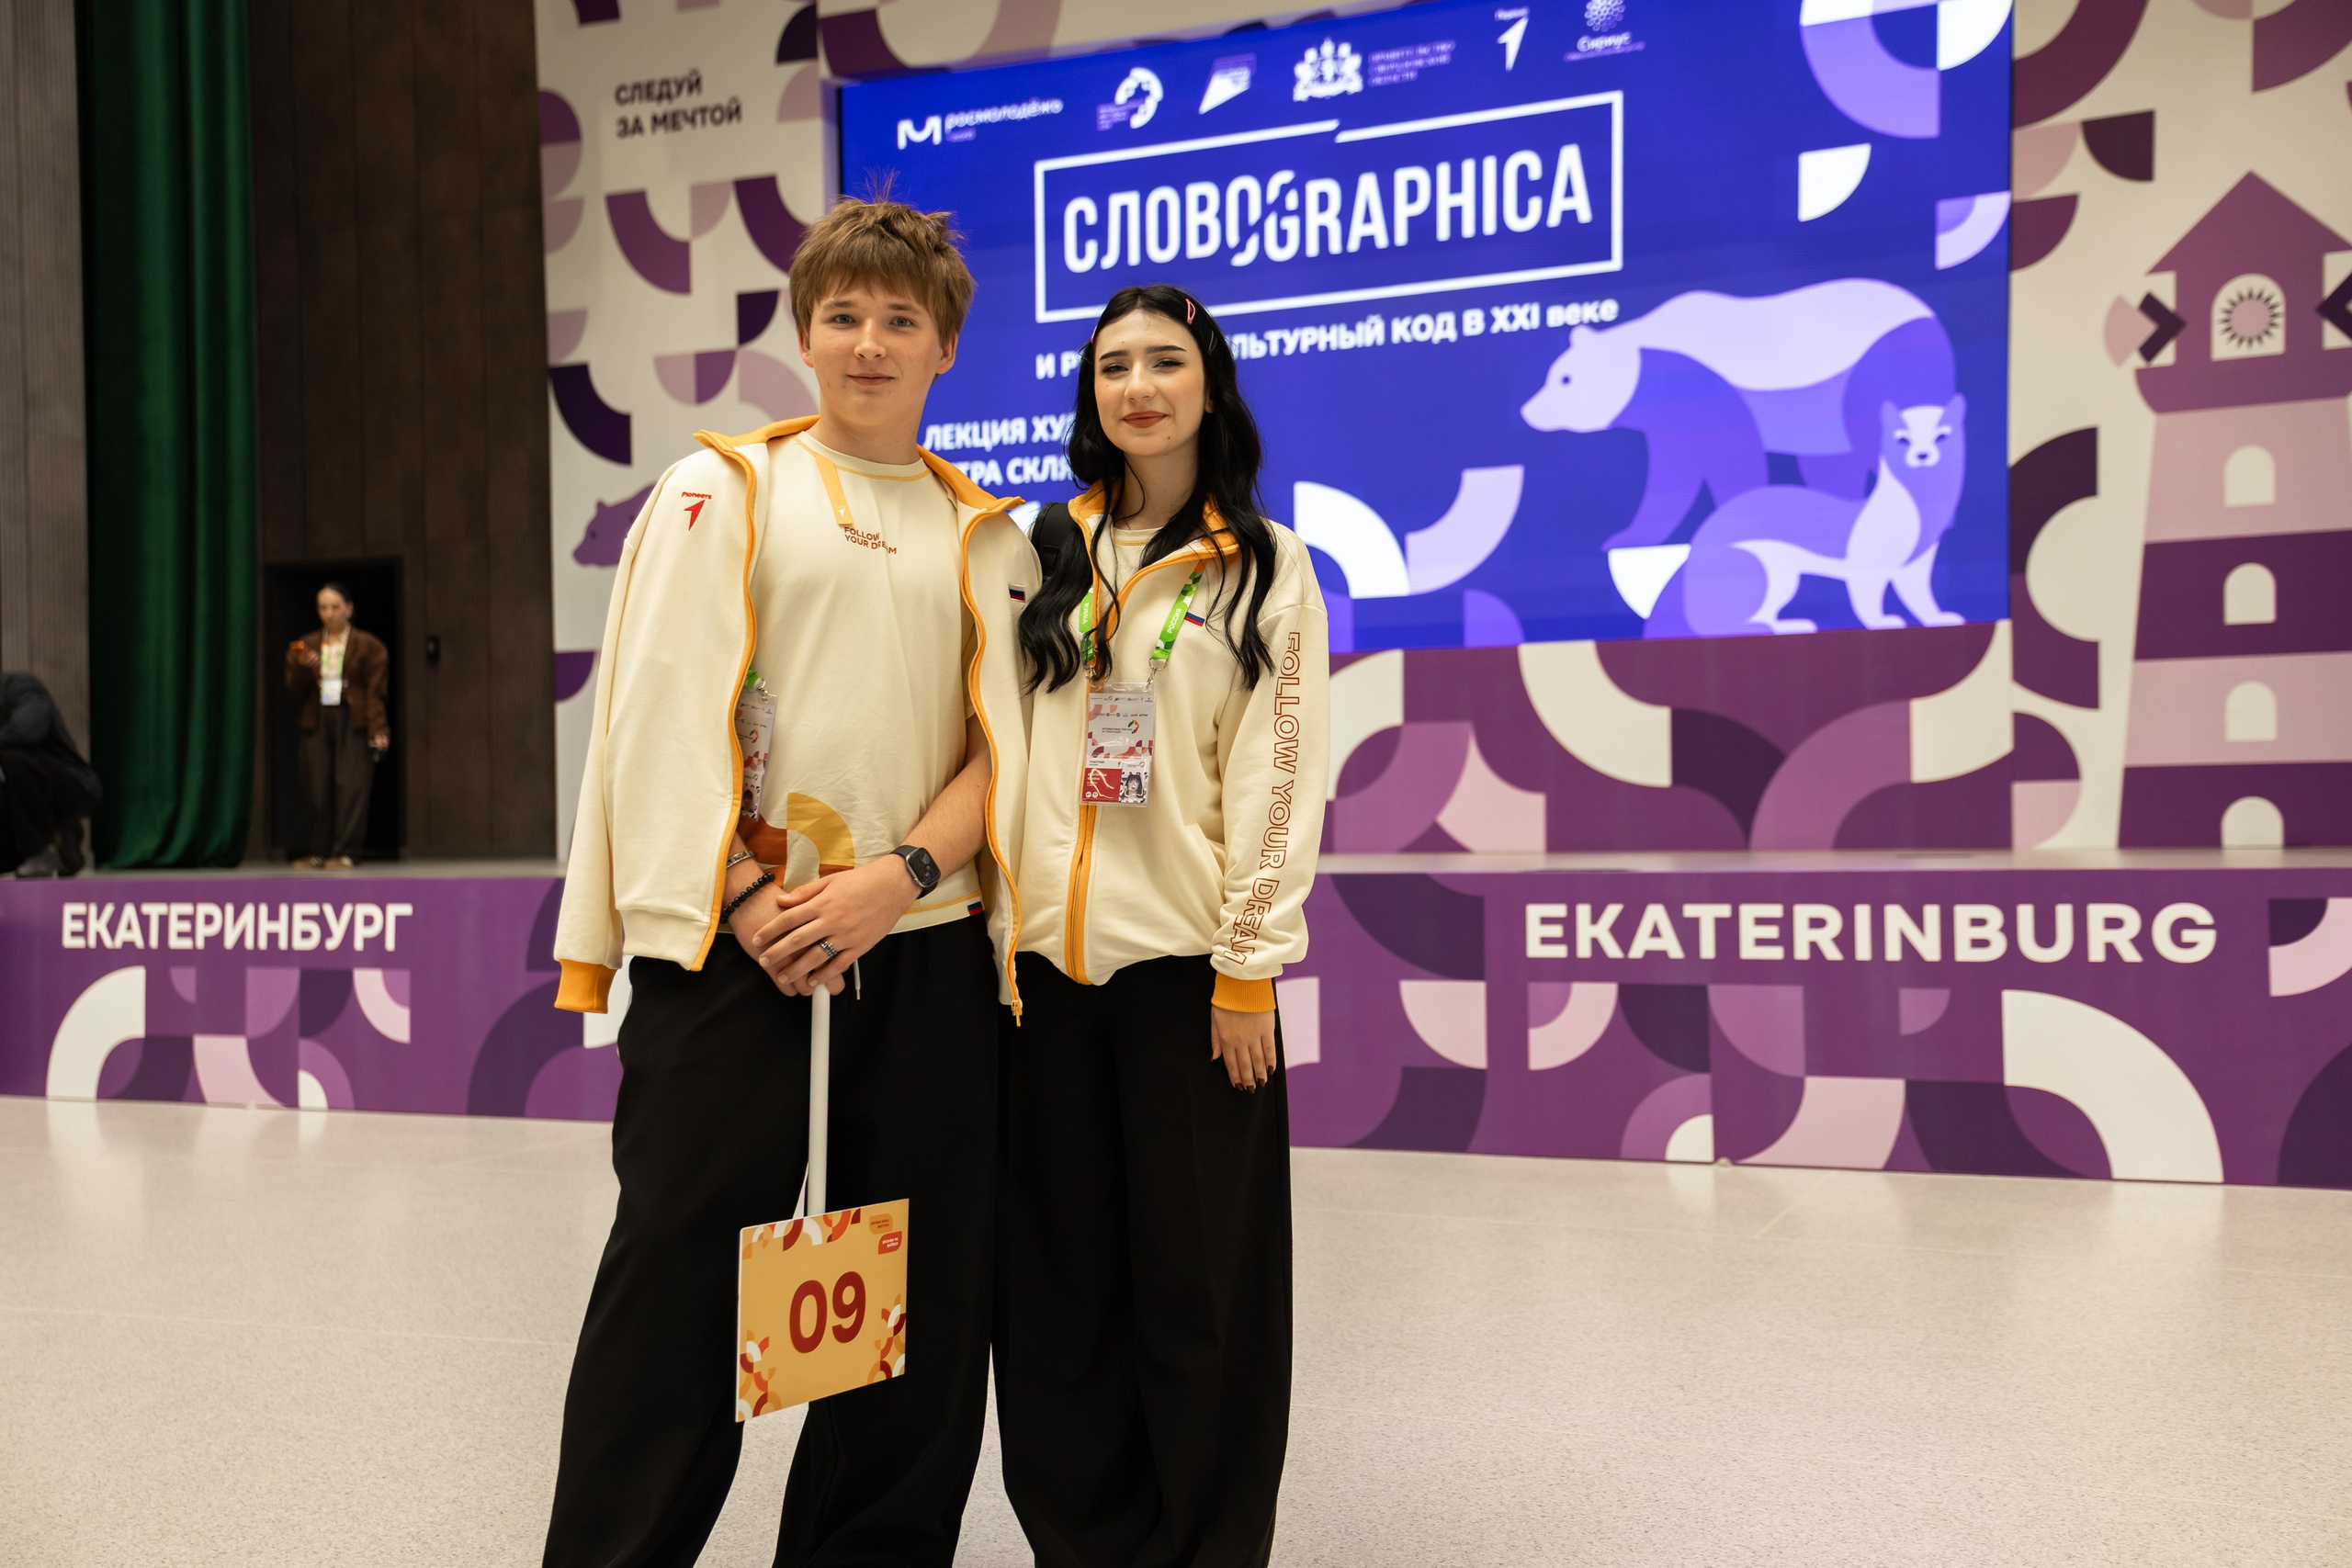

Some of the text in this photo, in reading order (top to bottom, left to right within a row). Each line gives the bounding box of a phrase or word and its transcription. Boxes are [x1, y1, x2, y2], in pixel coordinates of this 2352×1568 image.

[614, 68, 702, 106] СЛЕДУЙ
[616, 96, 742, 139] ЗА МЕЧТОЙ
[1035, 353, 1056, 379] И
[1226, 313, 1385, 360] ЛЬТУРНЫЙ
[1390, 310, 1458, 344] КОД
[1462, 308, 1486, 337] В
[1489, 301, 1541, 334] XXI
[1545, 298, 1620, 328] веке
[923, 416, 1027, 452] ЛЕКЦИЯ
[951, 459, 1004, 487] ТРА
[844, 526, 880, 541] FOLLOW
[844, 534, 869, 548] YOUR
[1166, 608, 1182, 634] РОССИЯ
[1273, 632, 1300, 774] FOLLOW
[1259, 779, 1295, 870] YOUR
[61, 902, 413, 952] ЕКАТЕРИНБУРГ
[1525, 902, 2218, 964] EKATERINBURG
[789, 1271, 866, 1354] 09
